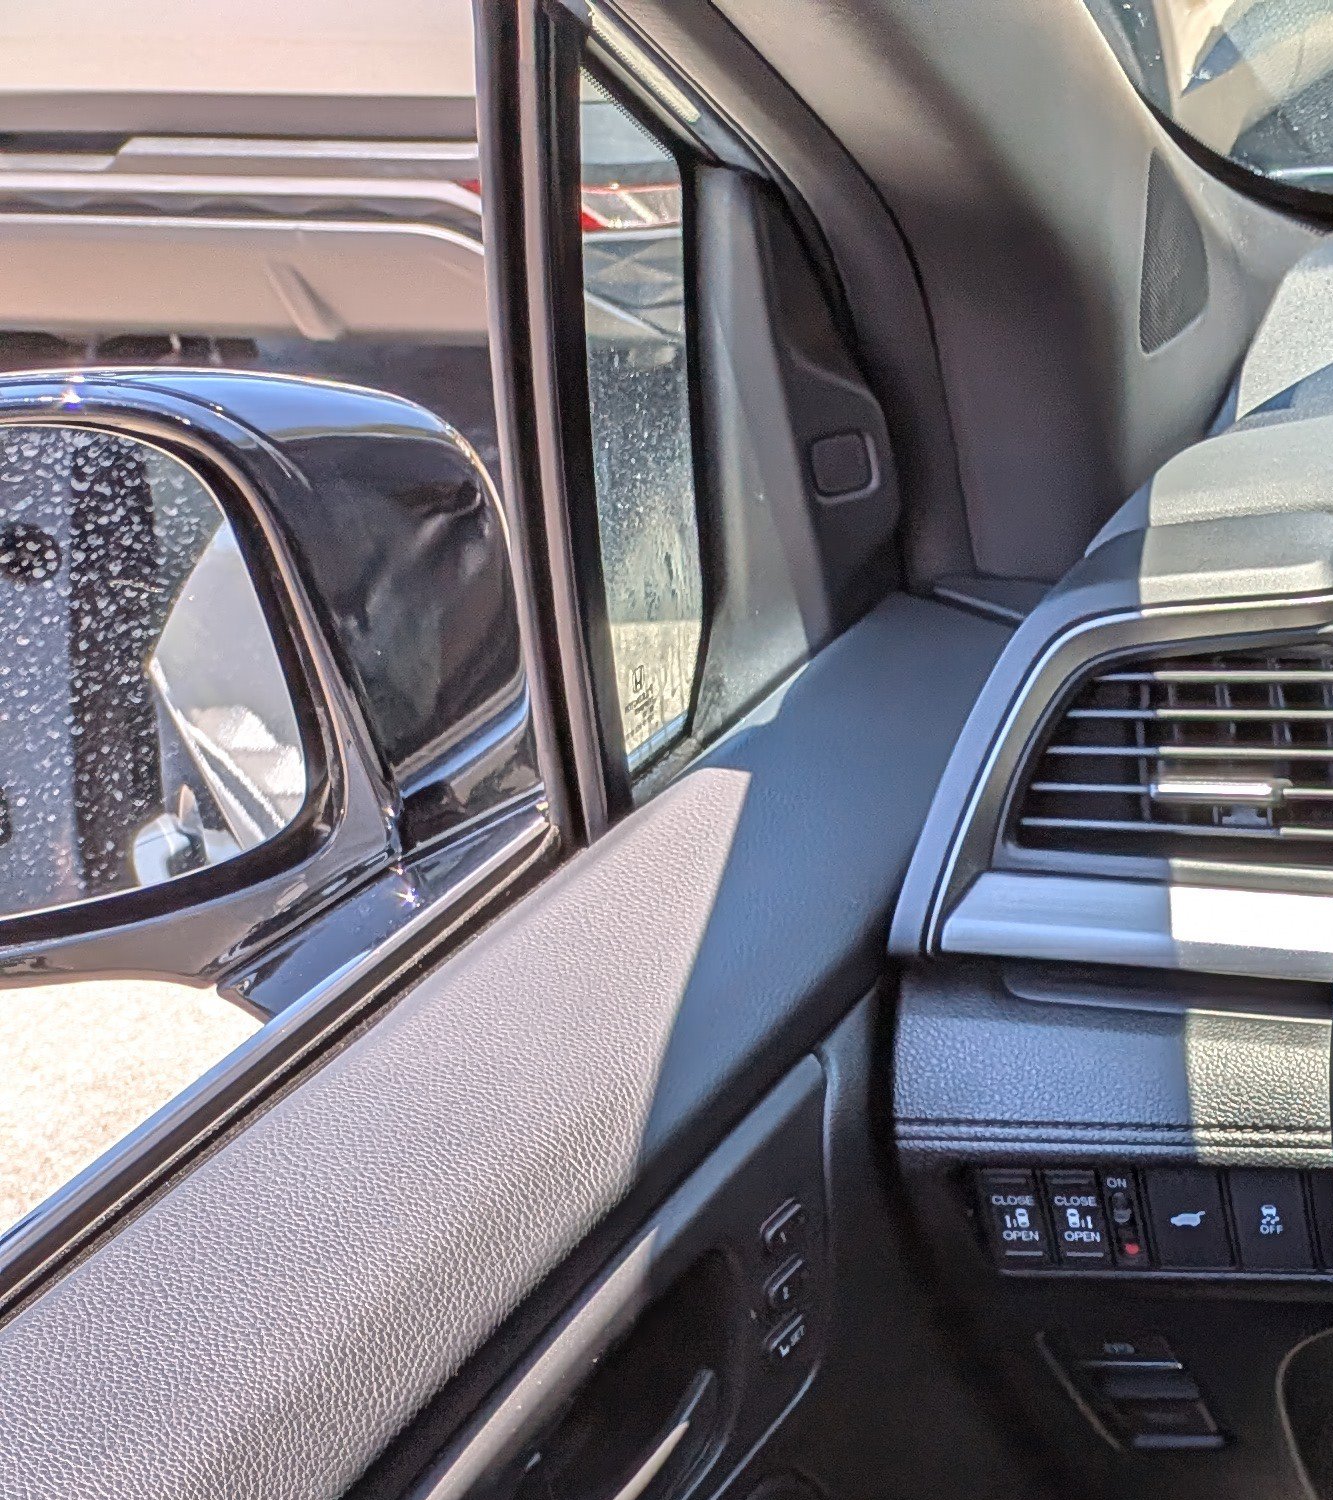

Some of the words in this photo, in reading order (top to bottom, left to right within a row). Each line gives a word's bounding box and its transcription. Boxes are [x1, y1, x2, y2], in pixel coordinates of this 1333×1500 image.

[1106, 1177, 1127, 1188] ON
[991, 1195, 1035, 1207] CLOSE
[1054, 1195, 1098, 1207] CLOSE
[1002, 1230, 1039, 1242] OPEN
[1064, 1230, 1100, 1242] OPEN
[1259, 1224, 1284, 1236] OFF
